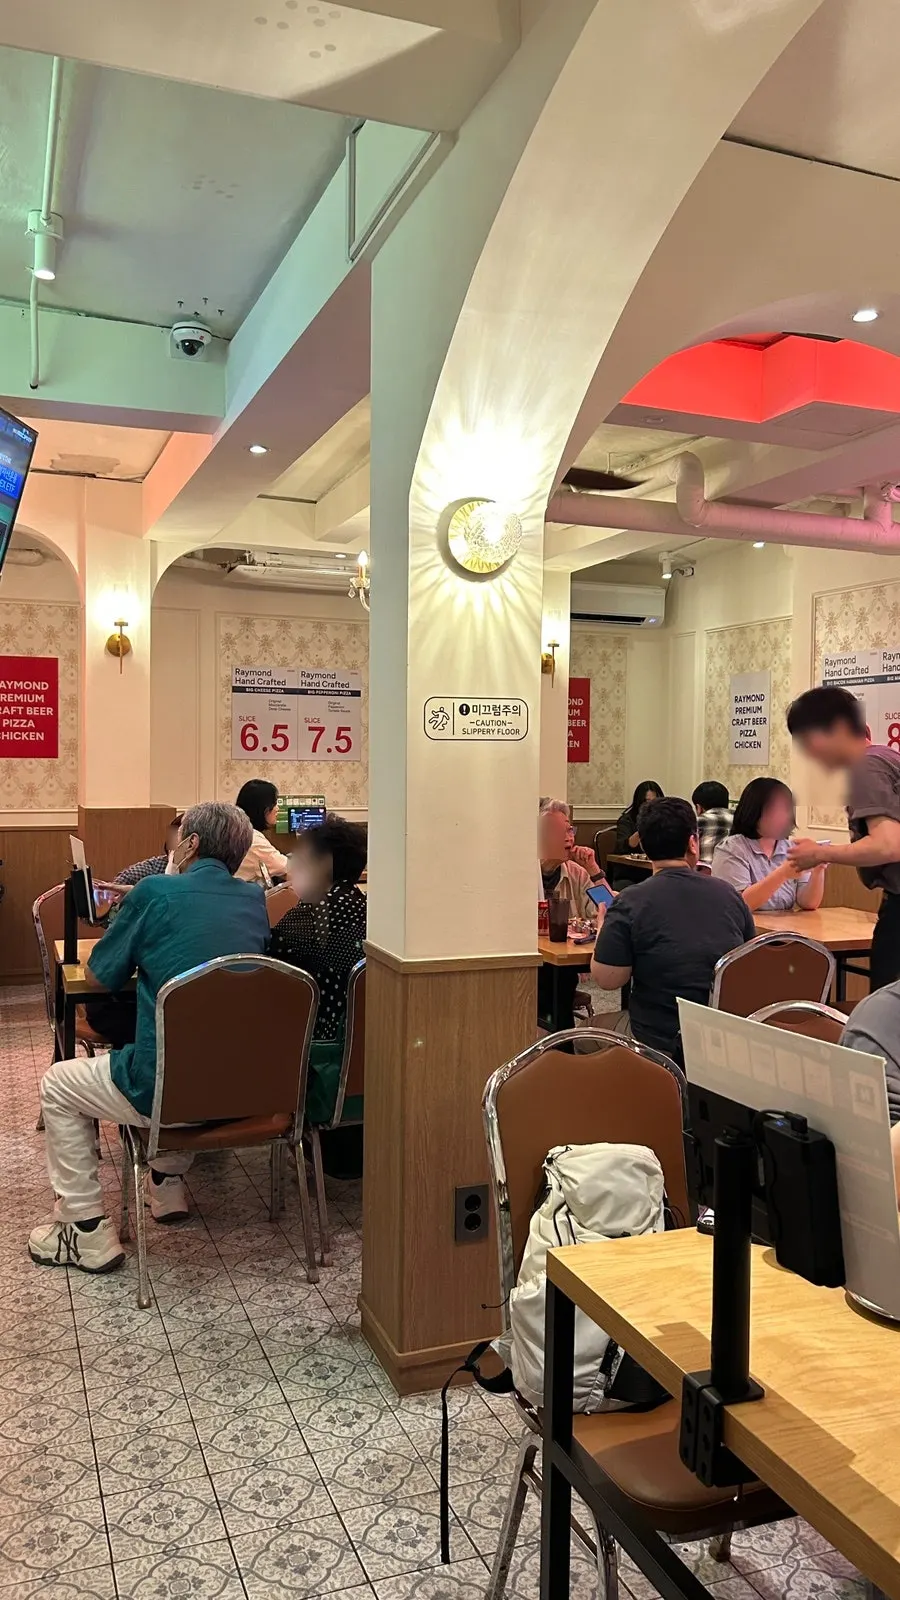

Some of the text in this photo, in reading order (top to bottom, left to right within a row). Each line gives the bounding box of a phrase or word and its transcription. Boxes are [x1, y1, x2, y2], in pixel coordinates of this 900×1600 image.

[825, 656, 856, 667] Raymond
[235, 668, 272, 677] Raymond
[301, 671, 336, 679] Raymond
[825, 666, 869, 677] Hand Crafted
[257, 678, 286, 686] Crafted
[301, 680, 320, 688] Hand
[734, 694, 765, 703] RAYMOND
[0, 706, 54, 716] AFT BEER
[471, 703, 521, 717] 미끄럼주의
[735, 706, 762, 714] PREMIUM
[2, 719, 35, 728] PIZZA
[731, 717, 767, 726] CRAFT BEER
[0, 731, 45, 741] HICKEN
[240, 723, 289, 752] 6.5
[740, 729, 757, 737] PIZZA
[308, 726, 352, 753] 7.5
[734, 741, 761, 749] CHICKEN
[54, 1223, 83, 1262] NY
